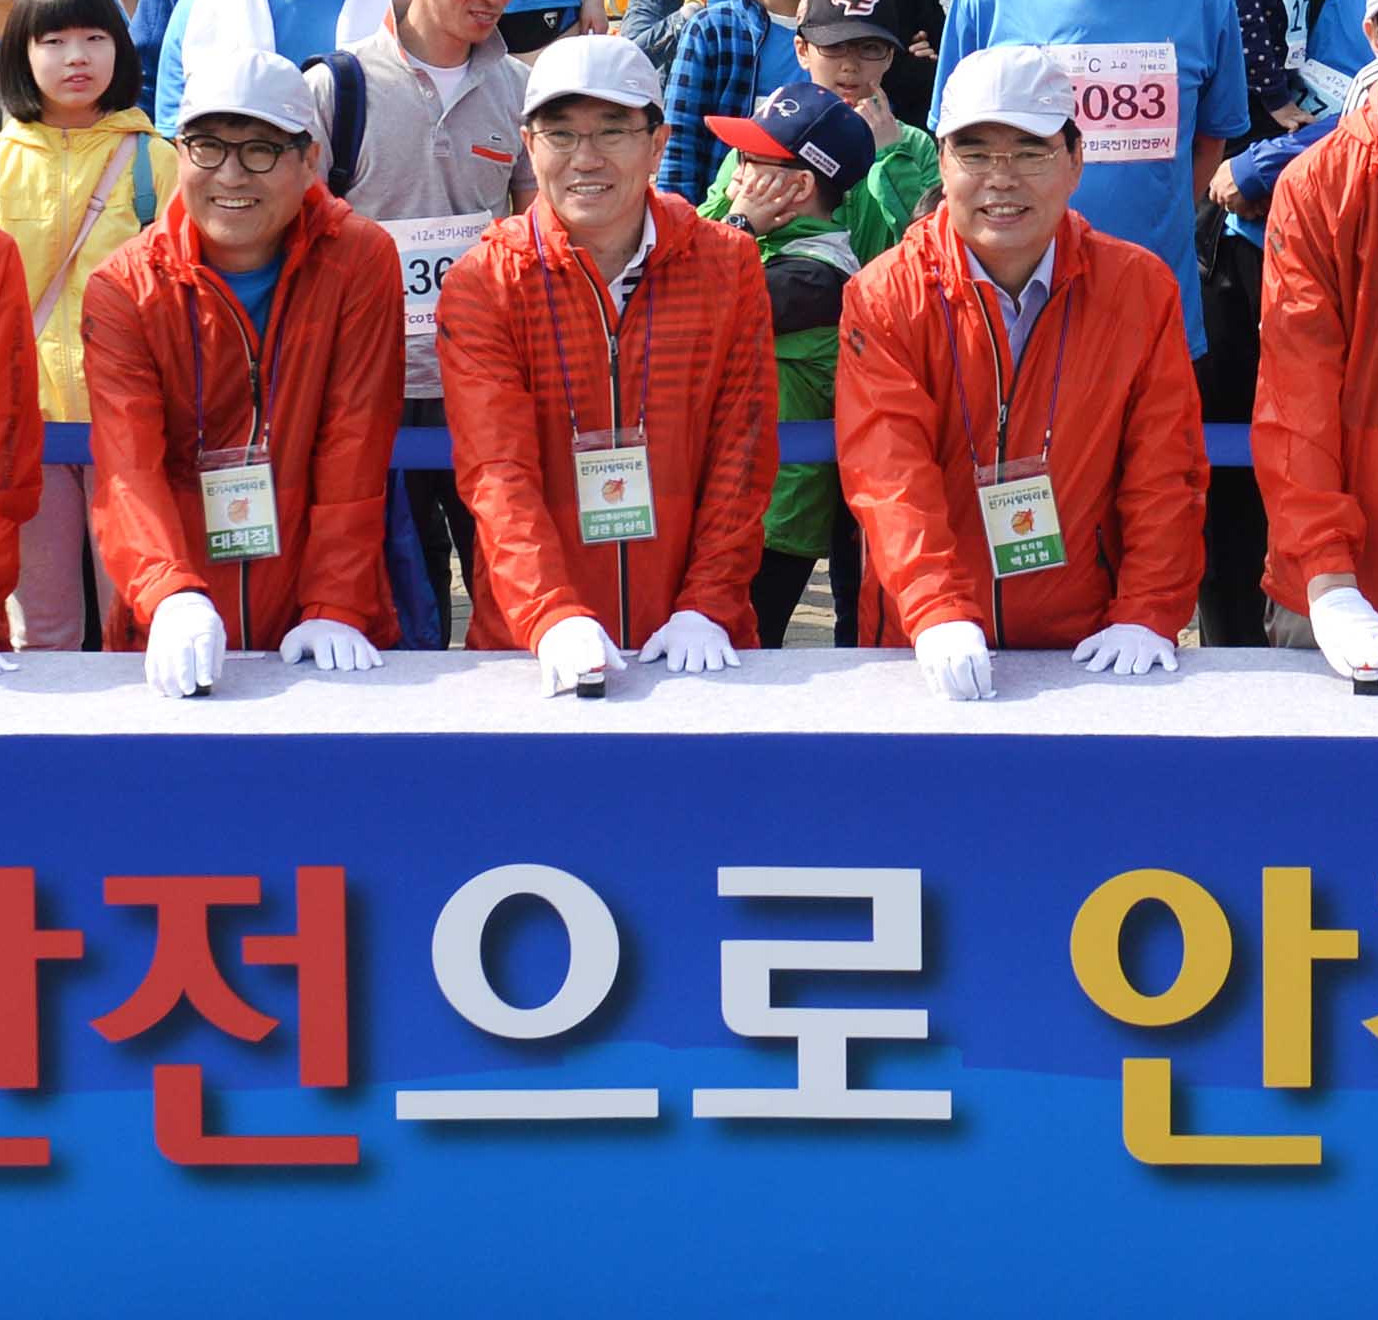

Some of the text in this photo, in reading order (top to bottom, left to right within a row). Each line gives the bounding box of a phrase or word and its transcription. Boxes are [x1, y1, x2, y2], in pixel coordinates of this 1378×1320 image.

[1088, 57, 1102, 73] C
[1087, 135, 1171, 155] 한국전기안전공사
[412, 230, 435, 242] 제12회
[580, 459, 644, 477] 전기사랑마라톤
[206, 480, 267, 498] 전기사랑마라톤
[988, 491, 1051, 511] 전기사랑마라톤
[210, 528, 270, 551] 대회장
